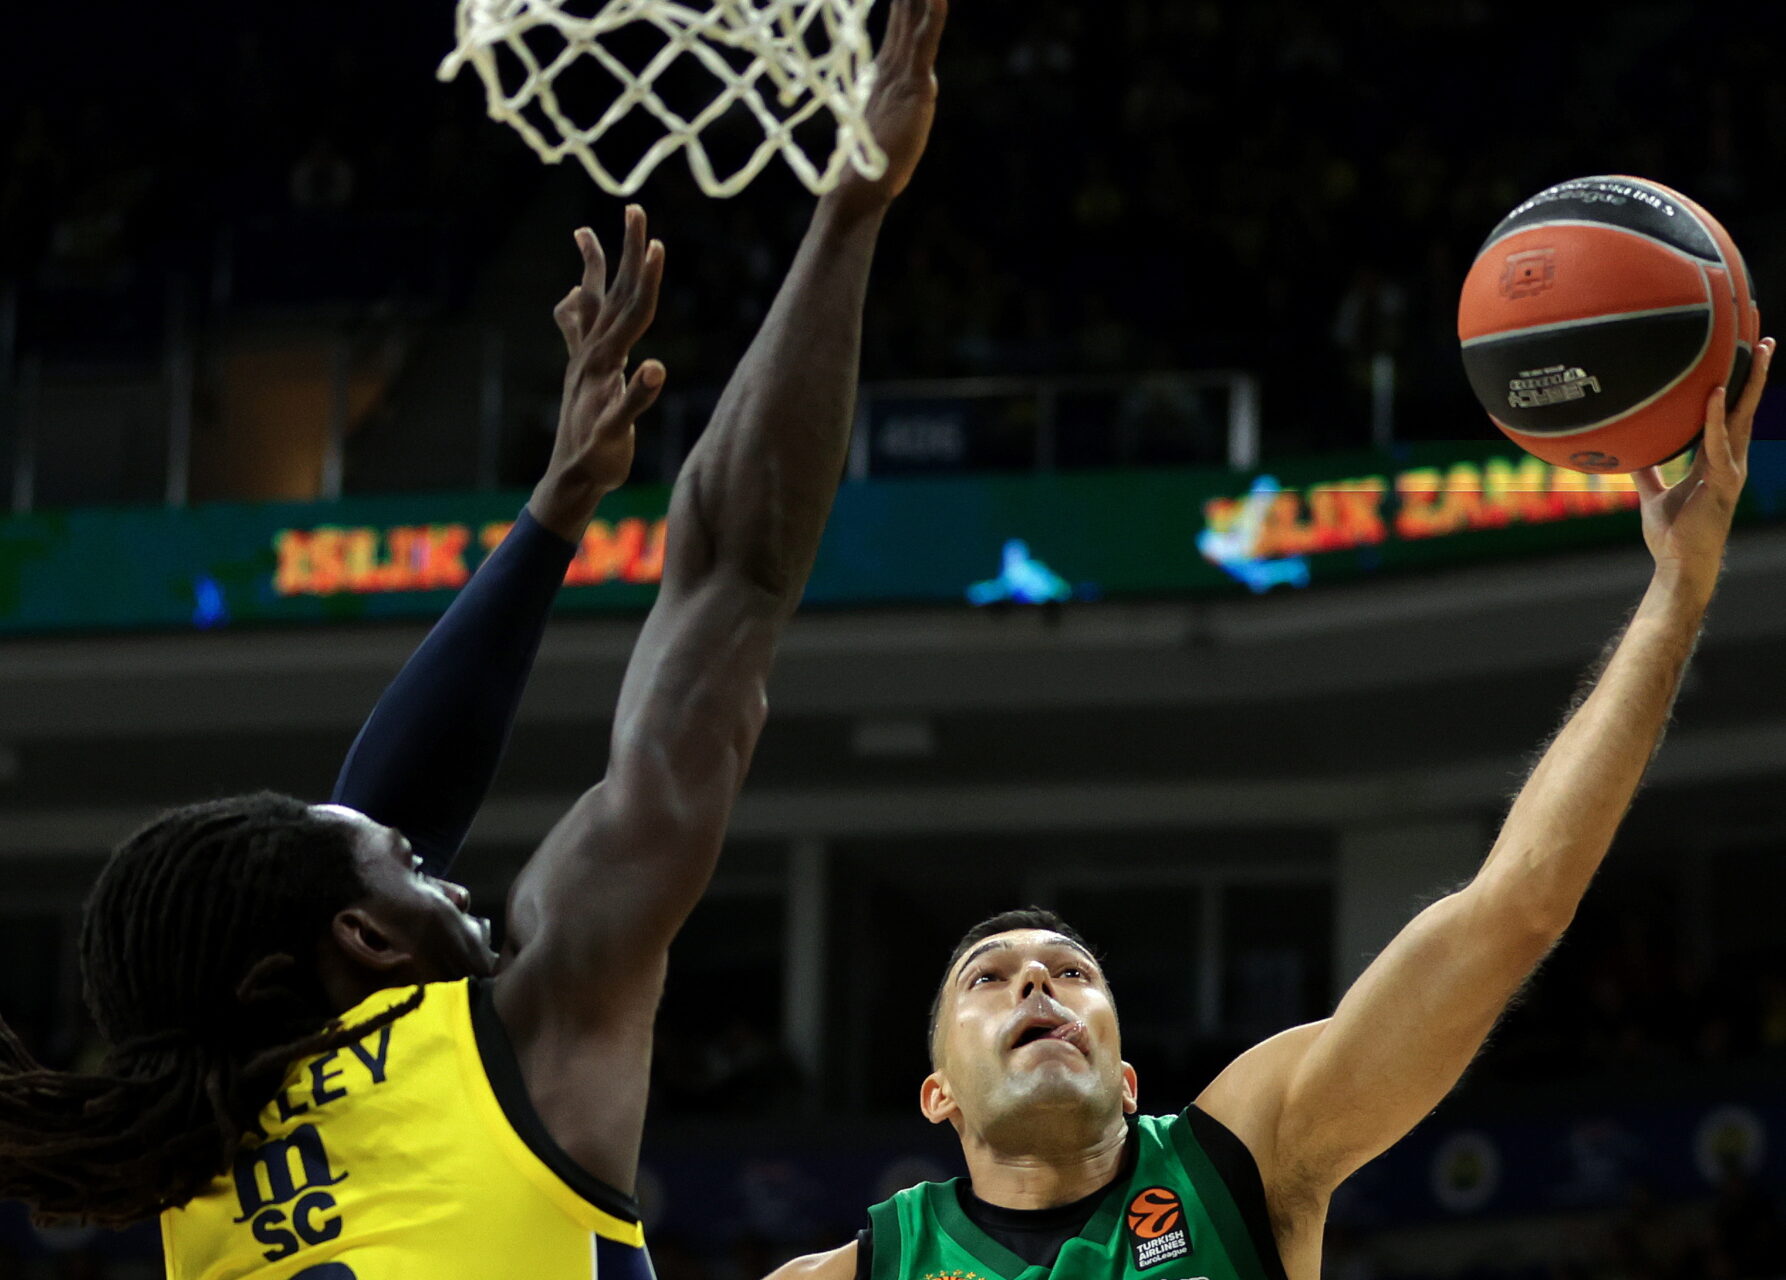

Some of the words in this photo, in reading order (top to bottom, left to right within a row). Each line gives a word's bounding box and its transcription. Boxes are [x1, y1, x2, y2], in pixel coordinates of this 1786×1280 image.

[1136, 1229, 1185, 1254] TURKISH
[1138, 1238, 1187, 1262] AIRLINES
[1138, 1246, 1188, 1268] EuroLeague
